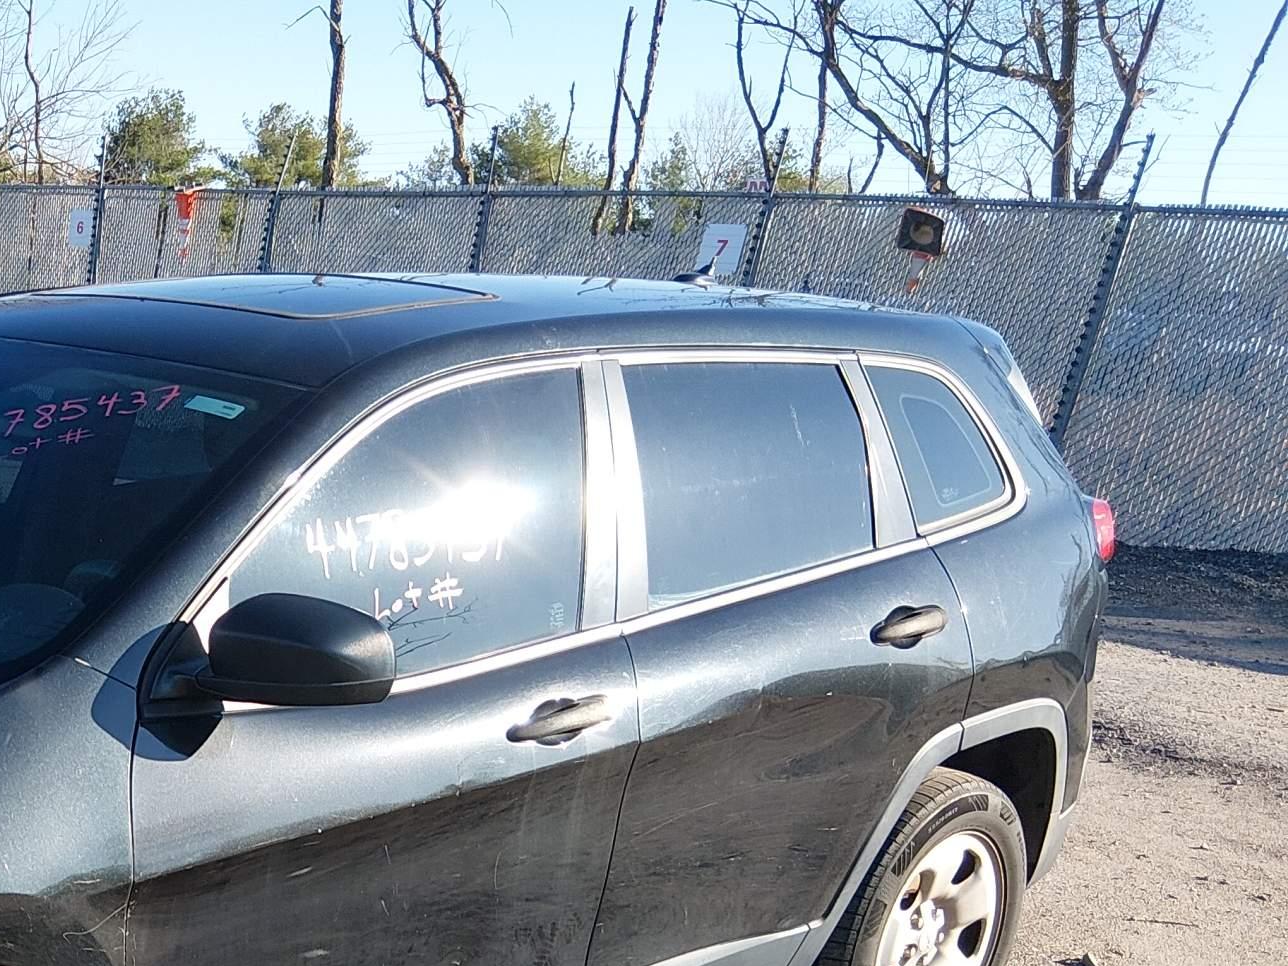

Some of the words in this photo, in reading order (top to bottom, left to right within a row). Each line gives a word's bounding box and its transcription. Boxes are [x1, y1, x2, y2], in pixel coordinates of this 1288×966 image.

[76, 220, 84, 234] 6
[716, 239, 729, 257] 7
[57, 426, 95, 444] #
[373, 580, 423, 621] Lot
[427, 571, 465, 610] #
